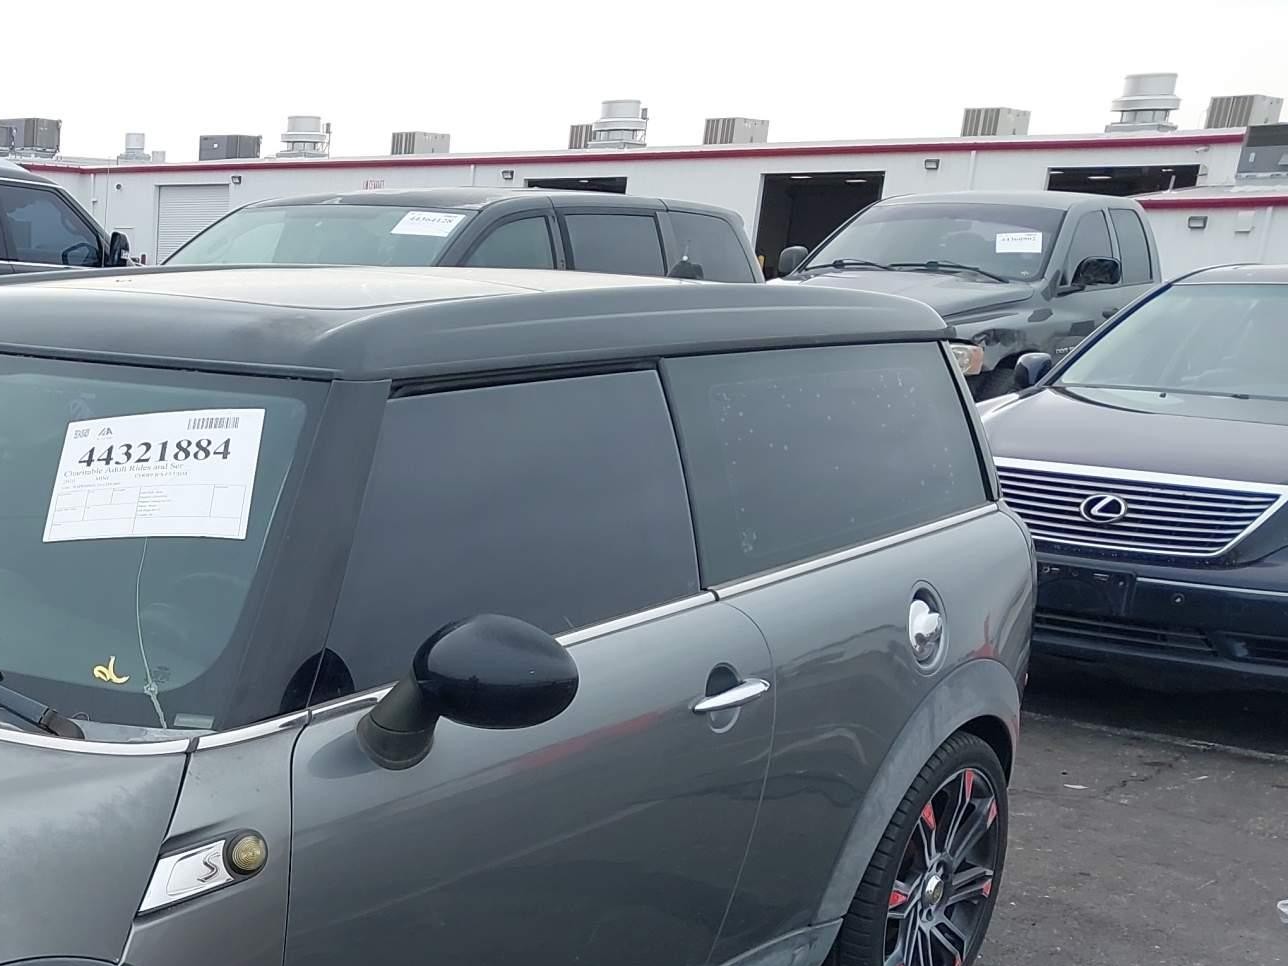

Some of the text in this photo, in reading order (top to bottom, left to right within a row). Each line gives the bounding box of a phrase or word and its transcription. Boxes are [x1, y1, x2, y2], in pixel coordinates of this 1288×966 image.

[78, 437, 231, 467] 44321884
[64, 467, 103, 478] Charitable
[105, 465, 127, 474] Adult
[129, 463, 152, 472] Rides
[153, 462, 168, 470] and
[197, 851, 221, 883] S
